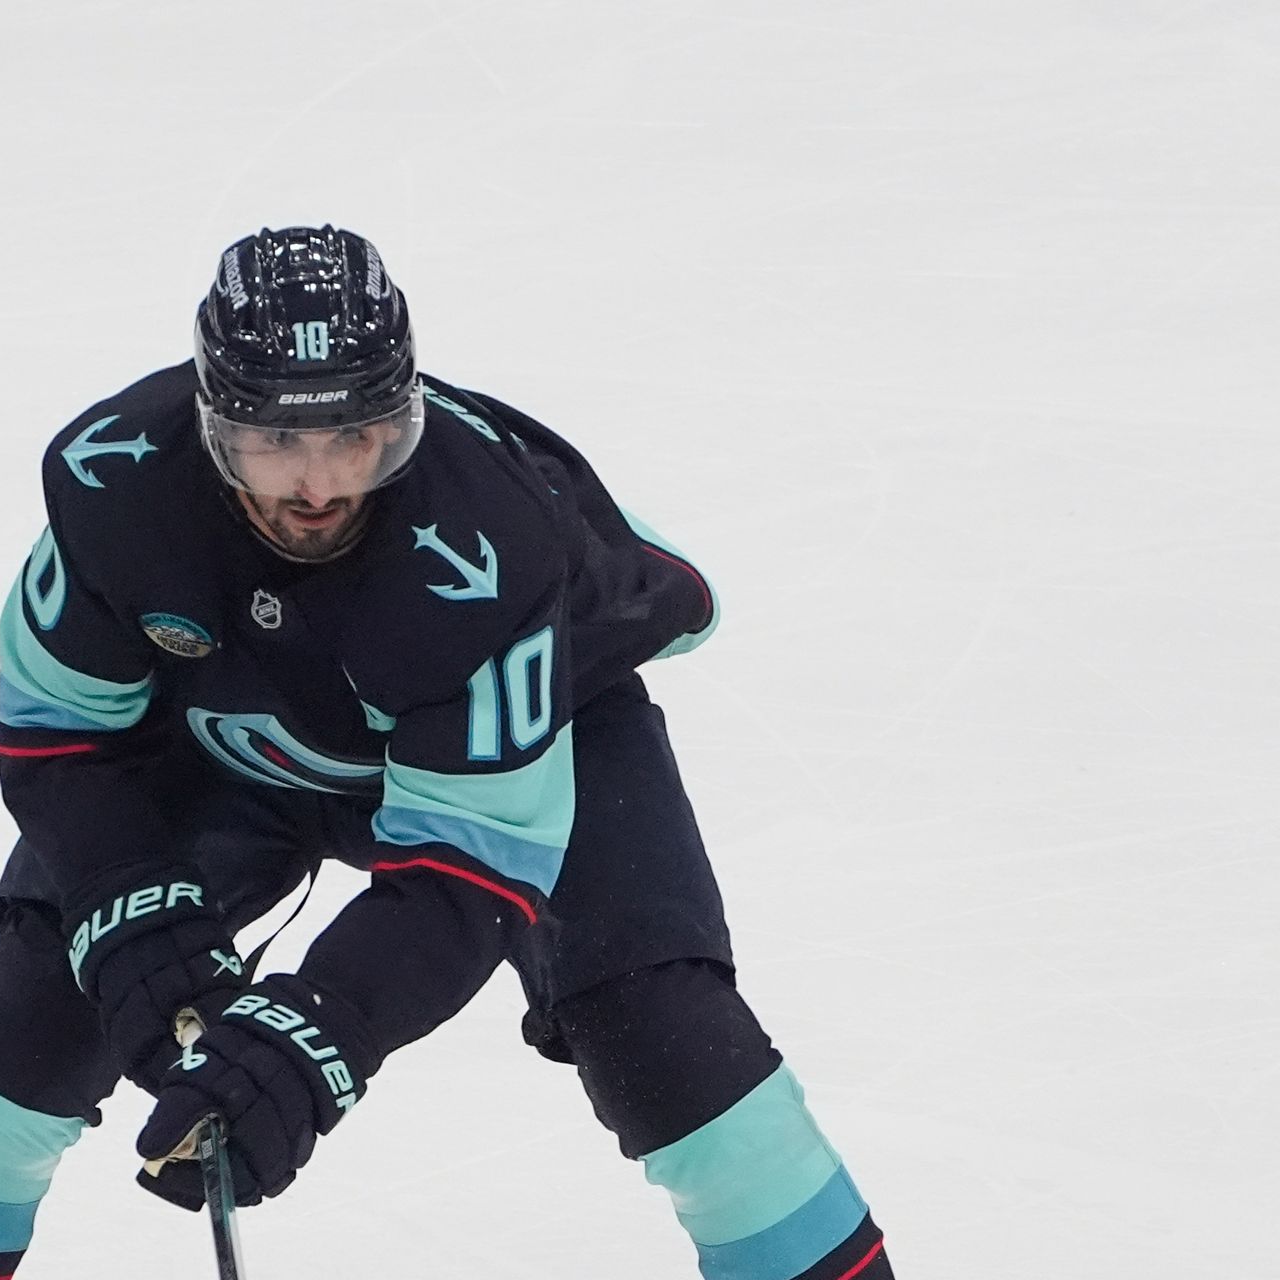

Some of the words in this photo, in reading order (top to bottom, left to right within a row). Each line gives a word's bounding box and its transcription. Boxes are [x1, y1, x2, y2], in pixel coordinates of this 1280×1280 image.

[291, 320, 330, 361] 10
[278, 389, 349, 405] BAUER
[21, 522, 67, 631] 0
[467, 625, 555, 763] 10
